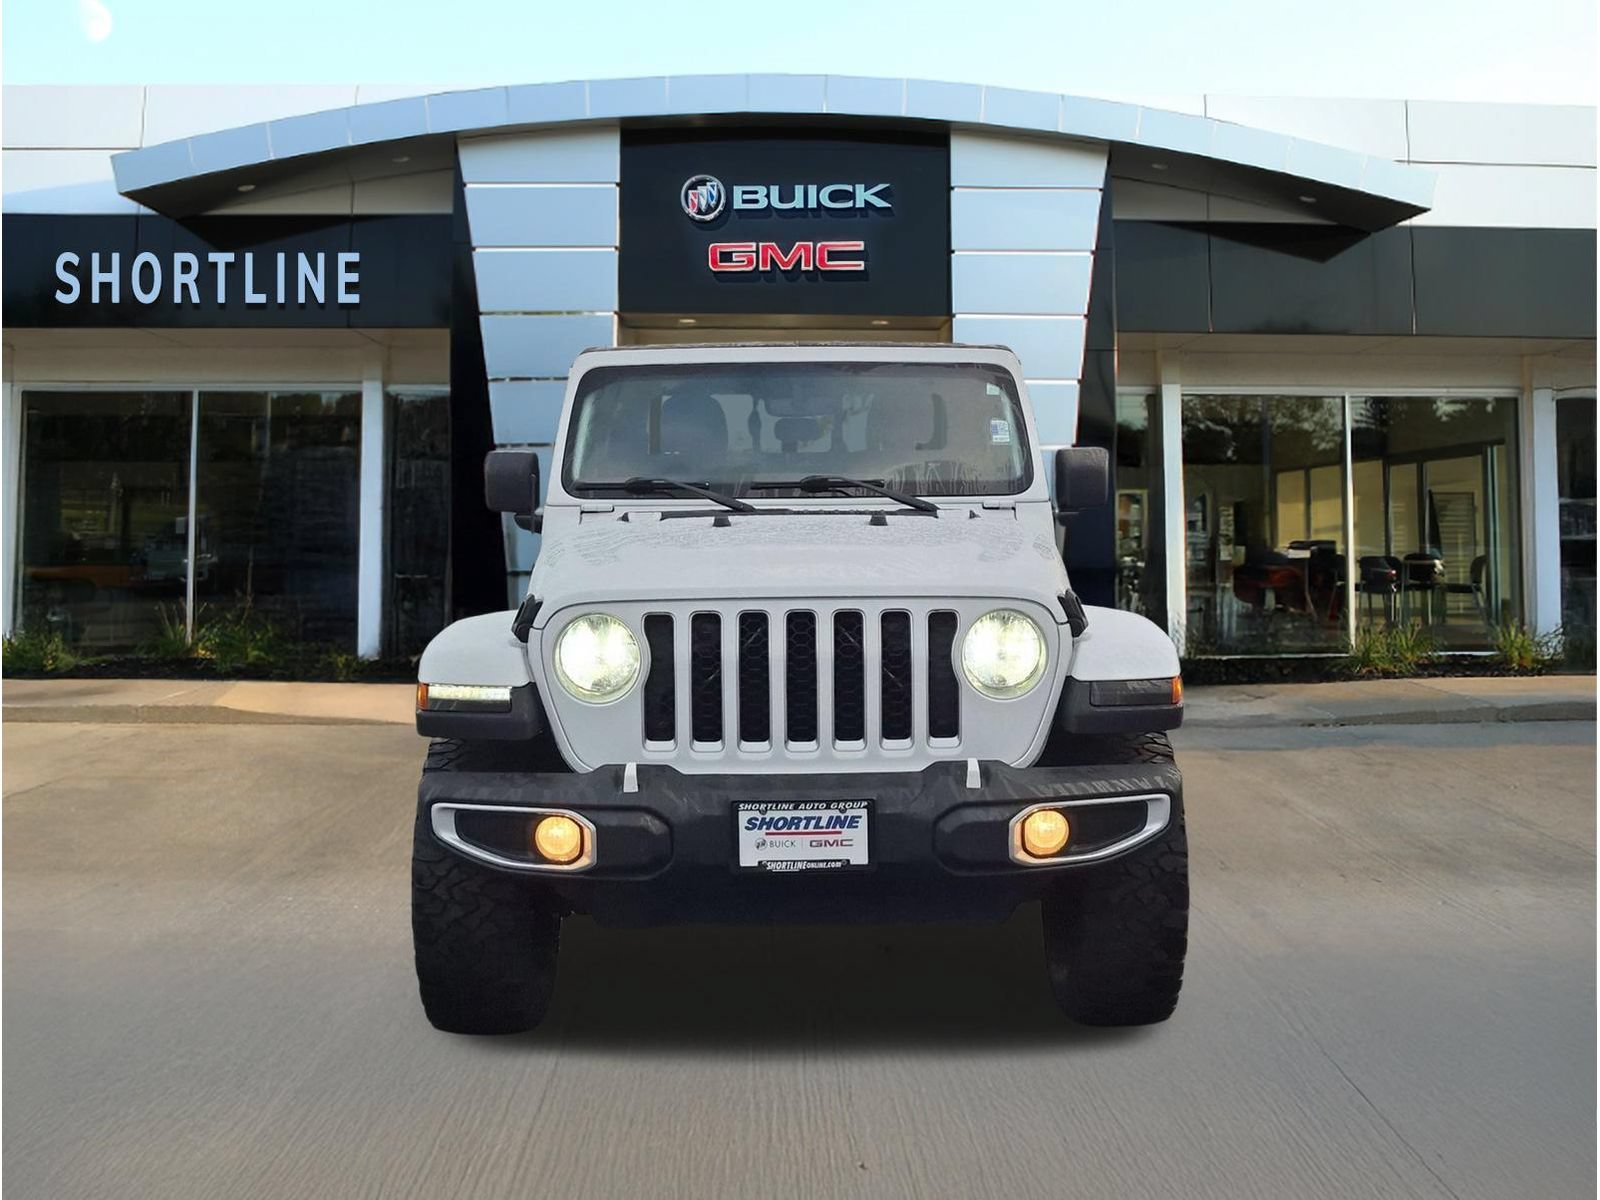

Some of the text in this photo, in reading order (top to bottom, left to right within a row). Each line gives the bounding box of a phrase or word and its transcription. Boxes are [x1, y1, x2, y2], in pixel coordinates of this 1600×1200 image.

[733, 183, 893, 210] BUICK
[708, 241, 865, 271] GMC
[55, 251, 360, 305] SHORTLINE
[738, 801, 868, 810] SHORTLINE AUTO GROUP
[744, 815, 862, 831] SHORTLINE
[769, 839, 797, 848] BUICK
[809, 838, 853, 848] GMC
